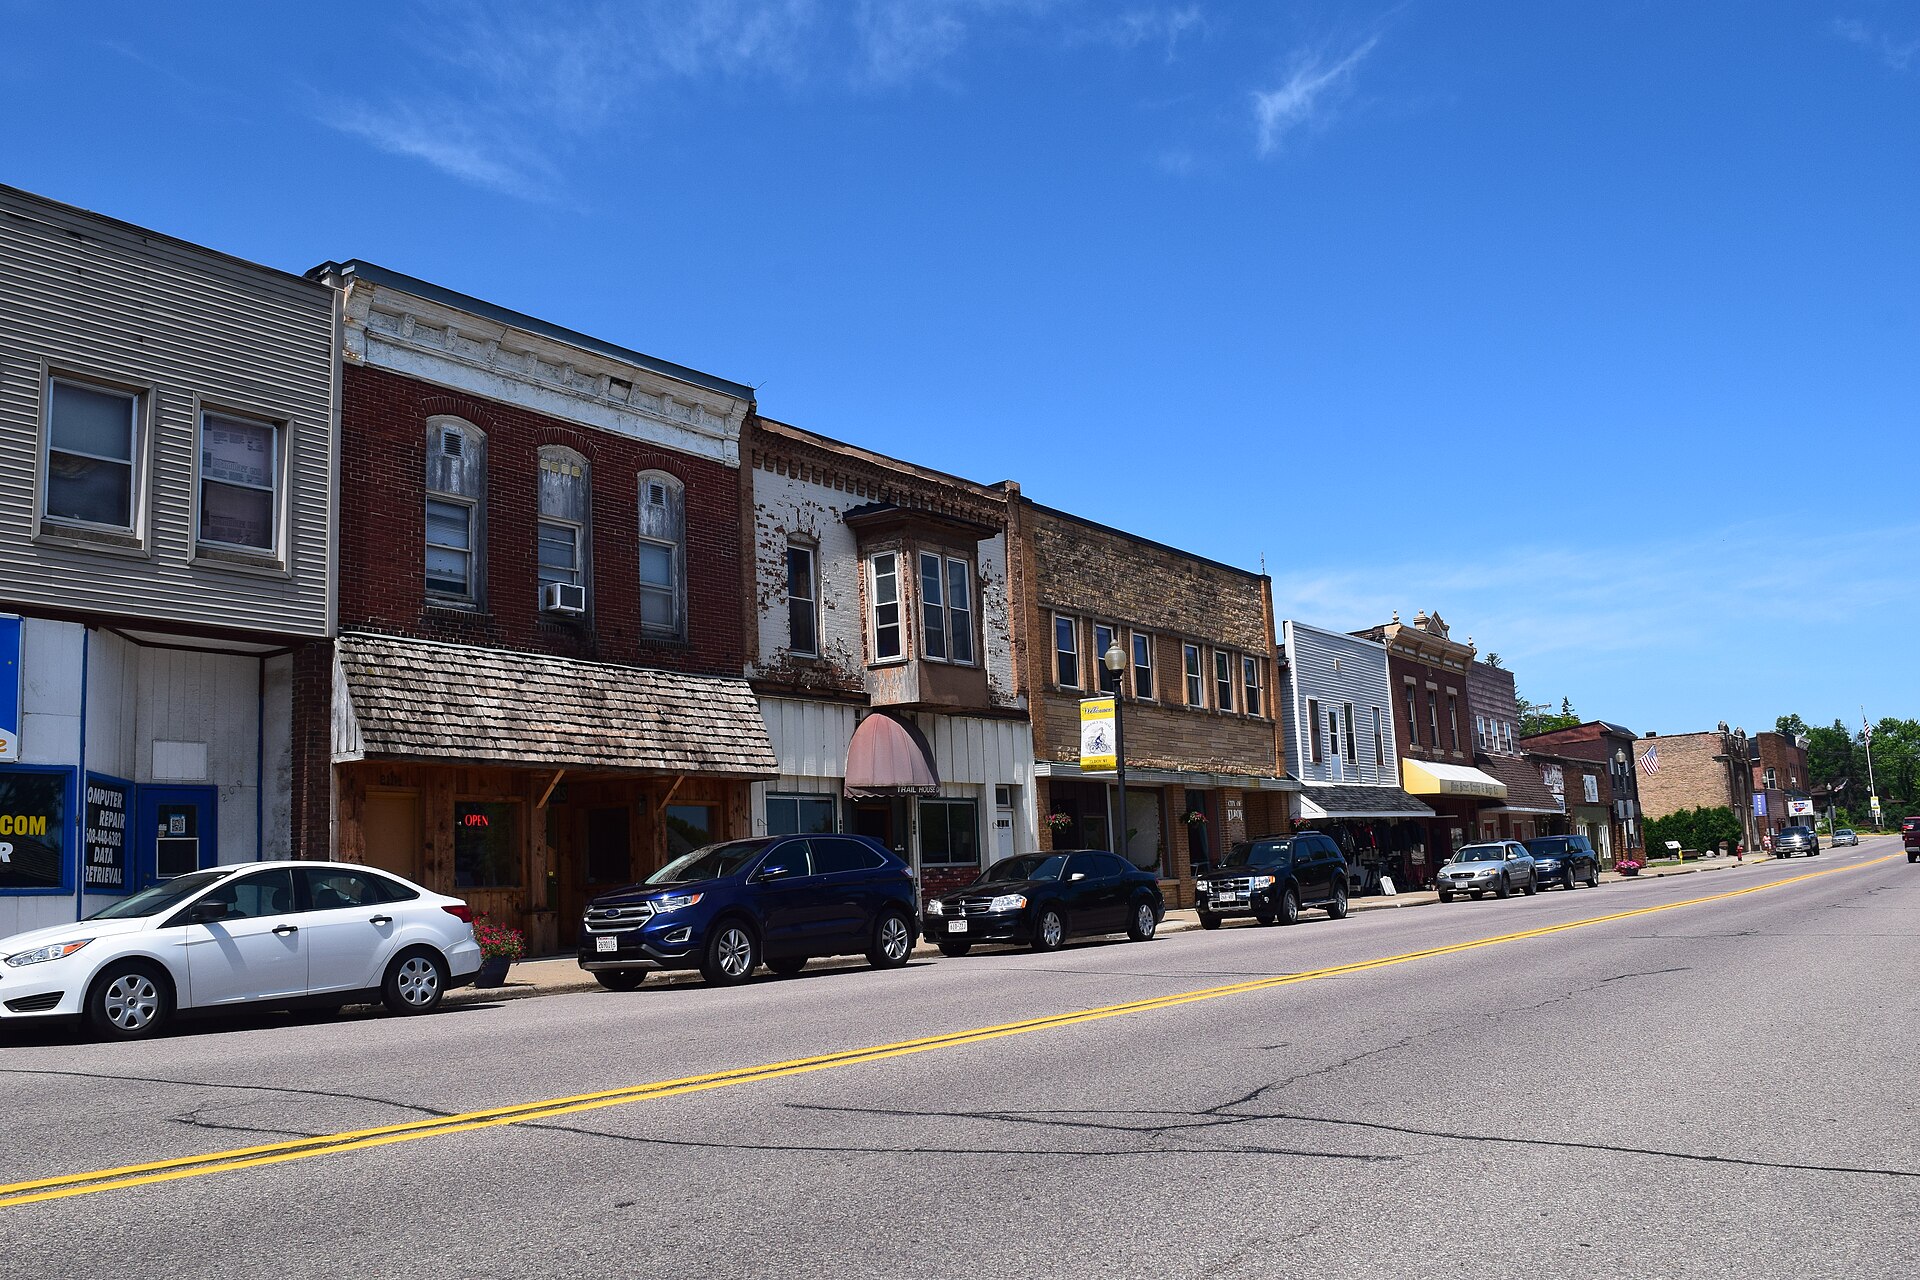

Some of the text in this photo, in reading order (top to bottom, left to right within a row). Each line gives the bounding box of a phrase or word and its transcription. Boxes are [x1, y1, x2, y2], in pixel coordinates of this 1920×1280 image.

[87, 786, 123, 809] OMPUTER
[99, 810, 126, 829] REPAIR
[464, 814, 489, 827] OPEN
[93, 846, 113, 864] DATA
[85, 865, 122, 884] RETRIEVAL
